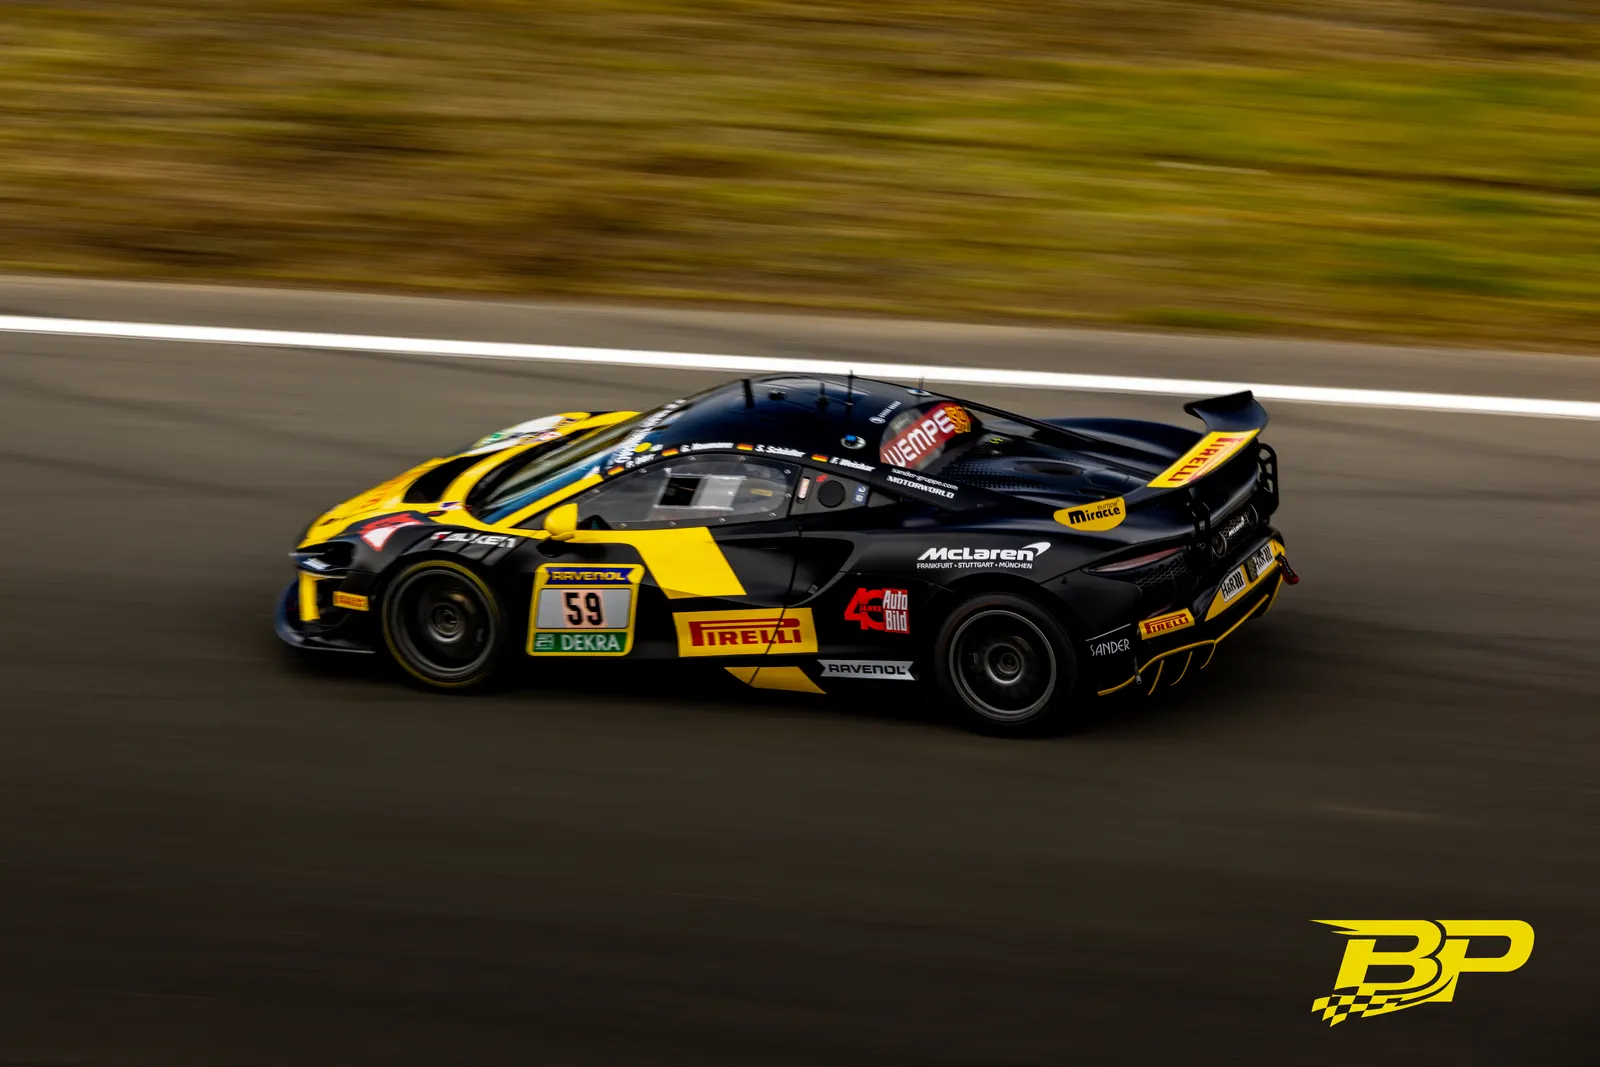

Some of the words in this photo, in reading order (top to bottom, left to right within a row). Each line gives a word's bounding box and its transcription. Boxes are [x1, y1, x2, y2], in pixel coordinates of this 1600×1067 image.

[883, 409, 956, 468] WEMPE
[1167, 437, 1246, 483] PIRELLI
[886, 475, 955, 499] MOTORWORLD
[891, 468, 959, 491] sander-gruppe.com
[917, 545, 1035, 561] McLaren
[550, 570, 626, 582] RAVENOL
[916, 562, 953, 570] FRANKFURT
[957, 561, 994, 569] STUTTGART
[998, 561, 1033, 570] MÜNCHEN
[563, 592, 604, 626] 59
[859, 604, 882, 613] JAHRE
[883, 589, 908, 610] Auto
[885, 610, 908, 632] Bild
[1144, 612, 1190, 635] PIRELLI
[560, 634, 621, 651] DEKRA
[688, 617, 802, 647] PIRELLI
[1089, 638, 1131, 657] SANDER
[828, 664, 905, 676] RAVENOL
